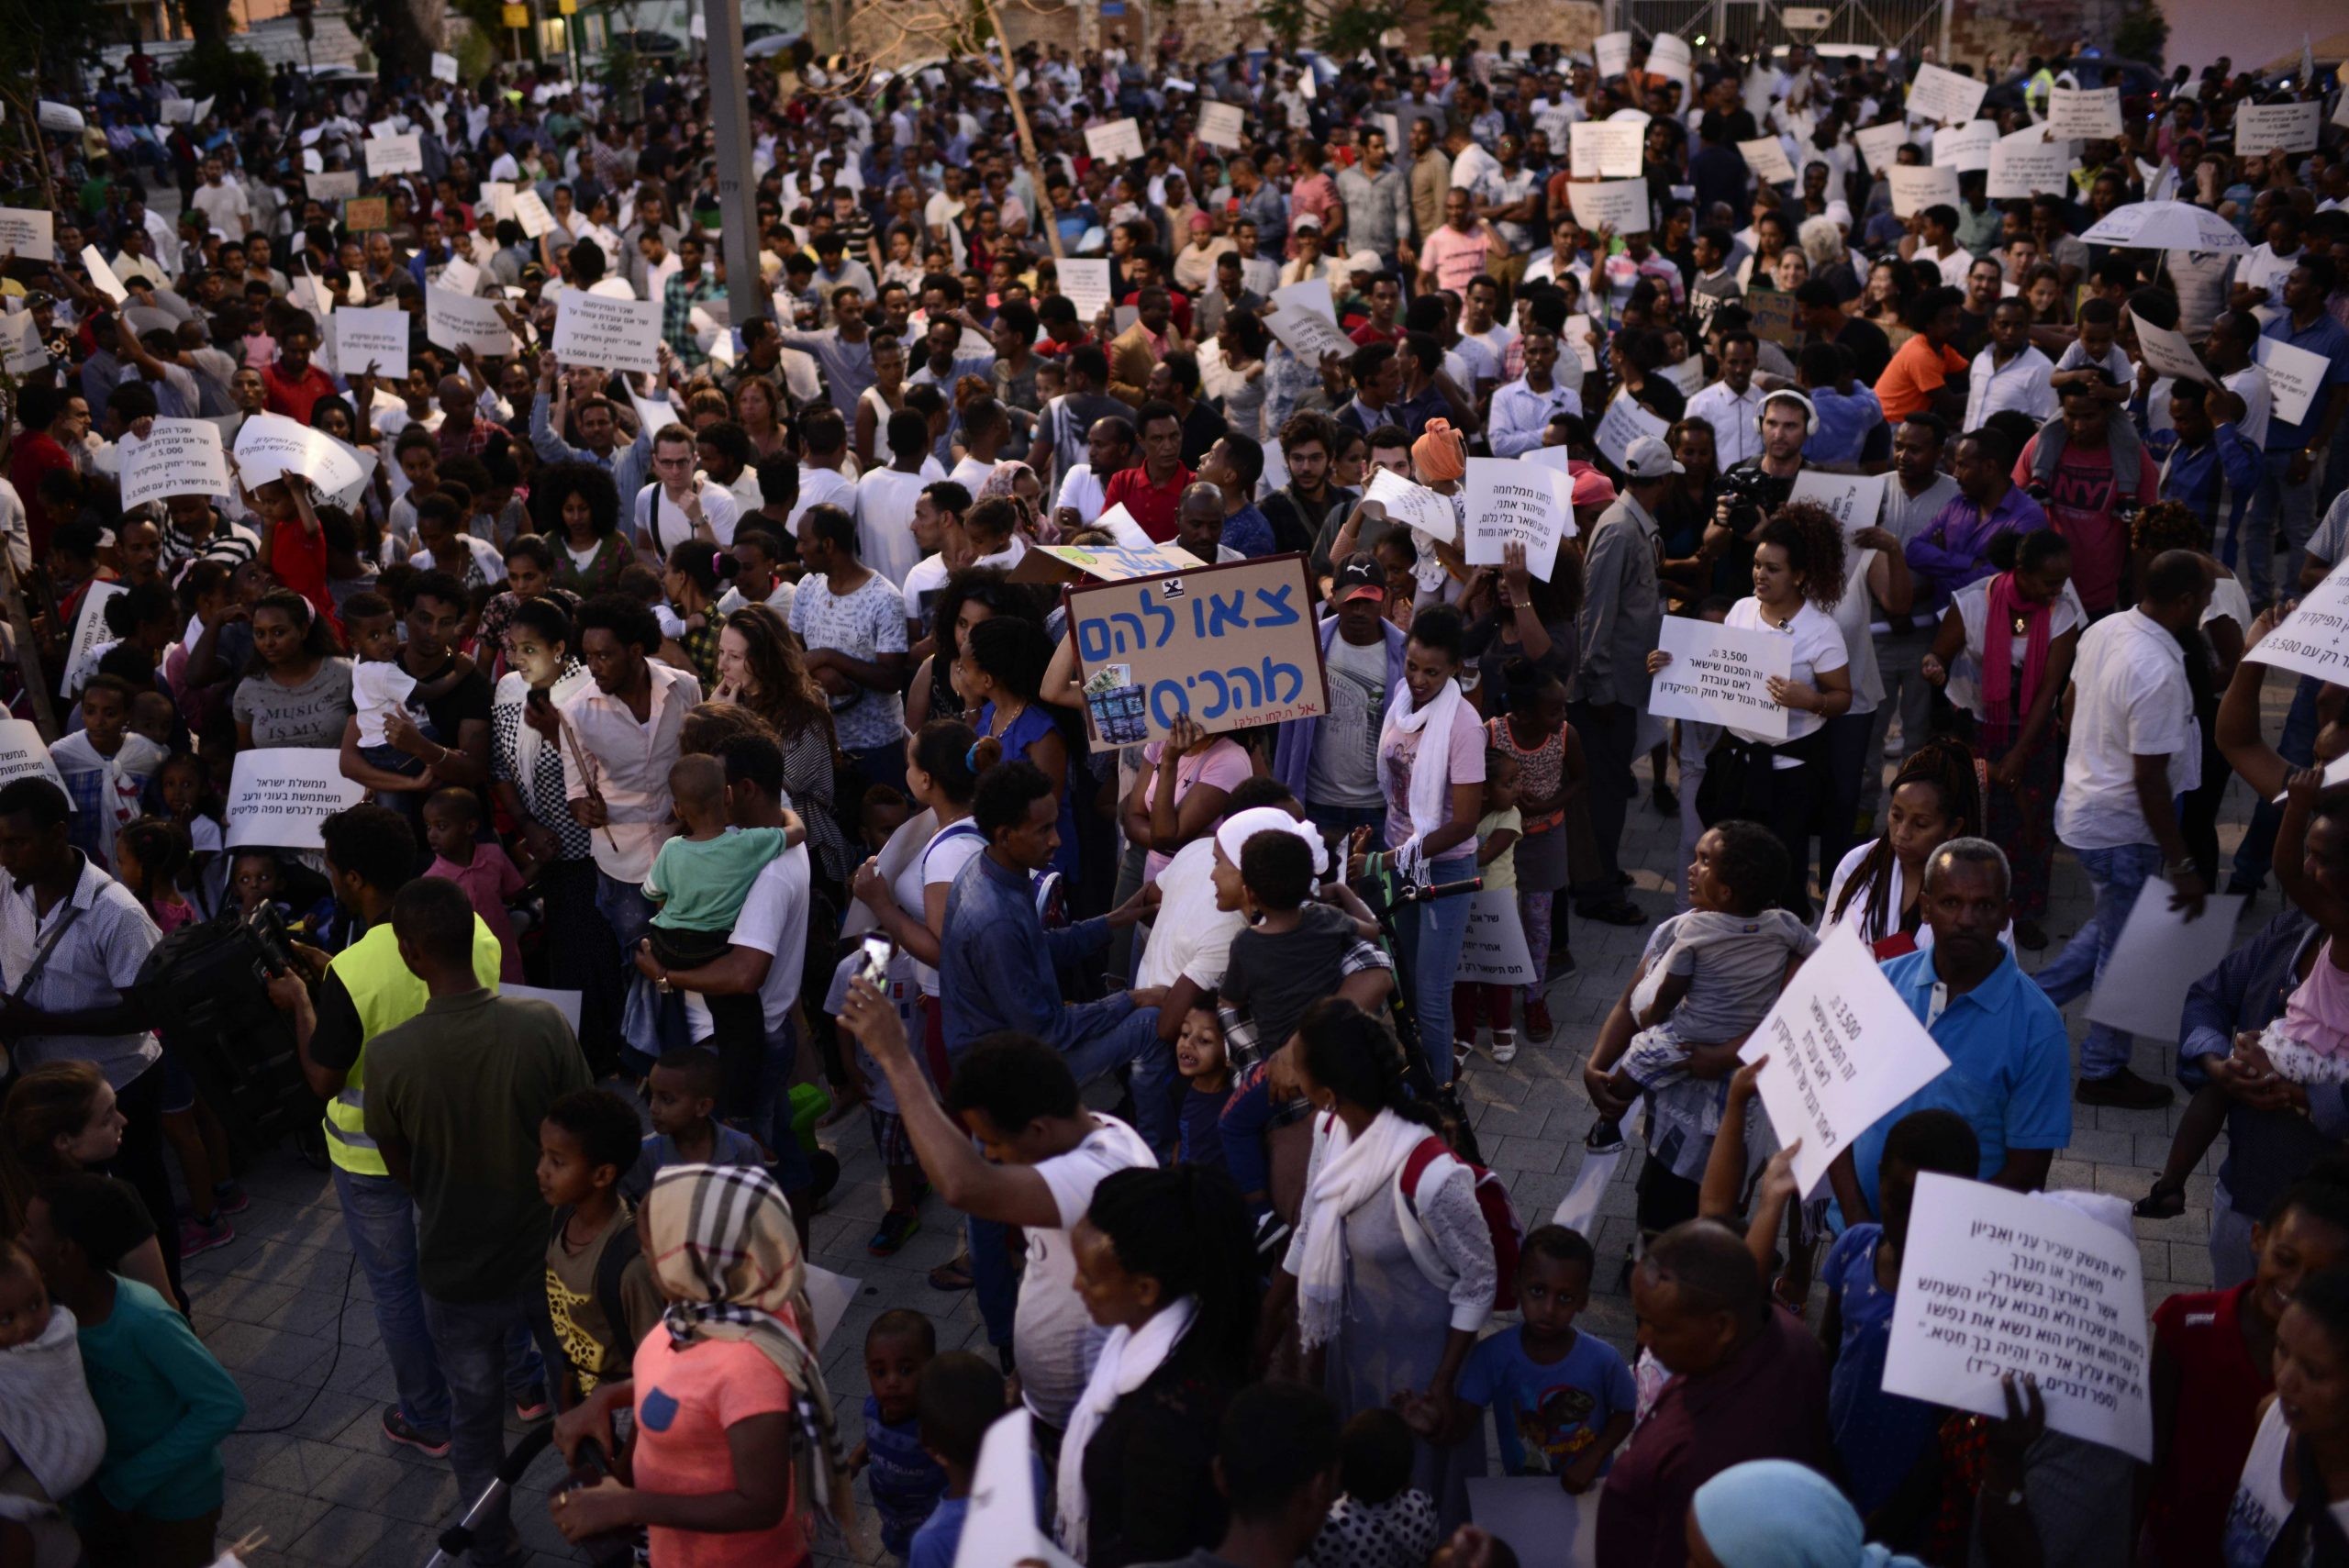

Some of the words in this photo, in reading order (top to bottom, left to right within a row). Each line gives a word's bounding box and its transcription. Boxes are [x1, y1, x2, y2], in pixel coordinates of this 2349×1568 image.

[154, 437, 180, 446] עובדת
[196, 437, 209, 445] של
[158, 447, 184, 456] 5,000
[132, 484, 150, 498] 3,500
[165, 480, 177, 490] רק
[1493, 485, 1534, 498] ממלחמה
[1479, 512, 1498, 524] כלום,
[1499, 512, 1514, 523] בלי
[1517, 515, 1538, 529] נשאר
[1478, 528, 1497, 538] ומוות
[1497, 528, 1530, 540] לכליאה
[1192, 584, 1300, 639] צאו
[87, 611, 98, 629] שכר
[1078, 588, 1175, 662] להם
[95, 627, 106, 644] עובד
[2268, 638, 2301, 653] 3,500
[2300, 645, 2321, 658] עם
[1721, 649, 1748, 662] 3,500
[2318, 650, 2339, 664] רק
[1689, 658, 1721, 671] שישאר
[1724, 663, 1751, 677] הסכום
[1700, 673, 1730, 686] עובדת
[1753, 671, 1763, 680] זה
[1660, 680, 1698, 695] הפיקדון
[1731, 679, 1751, 691] לאם
[1150, 656, 1304, 730] מהכיס
[1700, 687, 1719, 698] חוק
[1720, 690, 1735, 700] של
[1737, 693, 1756, 706] הגזל
[1758, 698, 1781, 712] לאחר
[266, 698, 327, 719] MUSIC
[1297, 702, 1318, 717] אל
[1234, 713, 1262, 729] חלק!
[269, 727, 286, 740] IS
[293, 720, 322, 735] MY
[0, 750, 28, 761] ממשל
[0, 762, 45, 776] משתמשת
[256, 777, 285, 788] ישראל
[288, 778, 327, 789] ממשלת
[242, 791, 262, 801] ורעב
[264, 792, 288, 802] בעוני
[292, 793, 341, 803] משתמשת
[231, 804, 258, 816] פליטים
[261, 805, 283, 815] מפה
[285, 805, 313, 816] לגרש
[1508, 964, 1523, 974] מס
[1809, 995, 1829, 1033] שישאר
[1836, 1003, 1862, 1041] 3,500
[1771, 1015, 1796, 1055] הפיקדון
[1802, 1029, 1820, 1063] עובדת
[1823, 1029, 1847, 1067] הסכום
[1787, 1051, 1802, 1076] חוק
[1814, 1060, 1831, 1087] לאם
[1841, 1062, 1856, 1083] זה
[1797, 1068, 1809, 1092] של
[1816, 1111, 1837, 1149] לאחר
